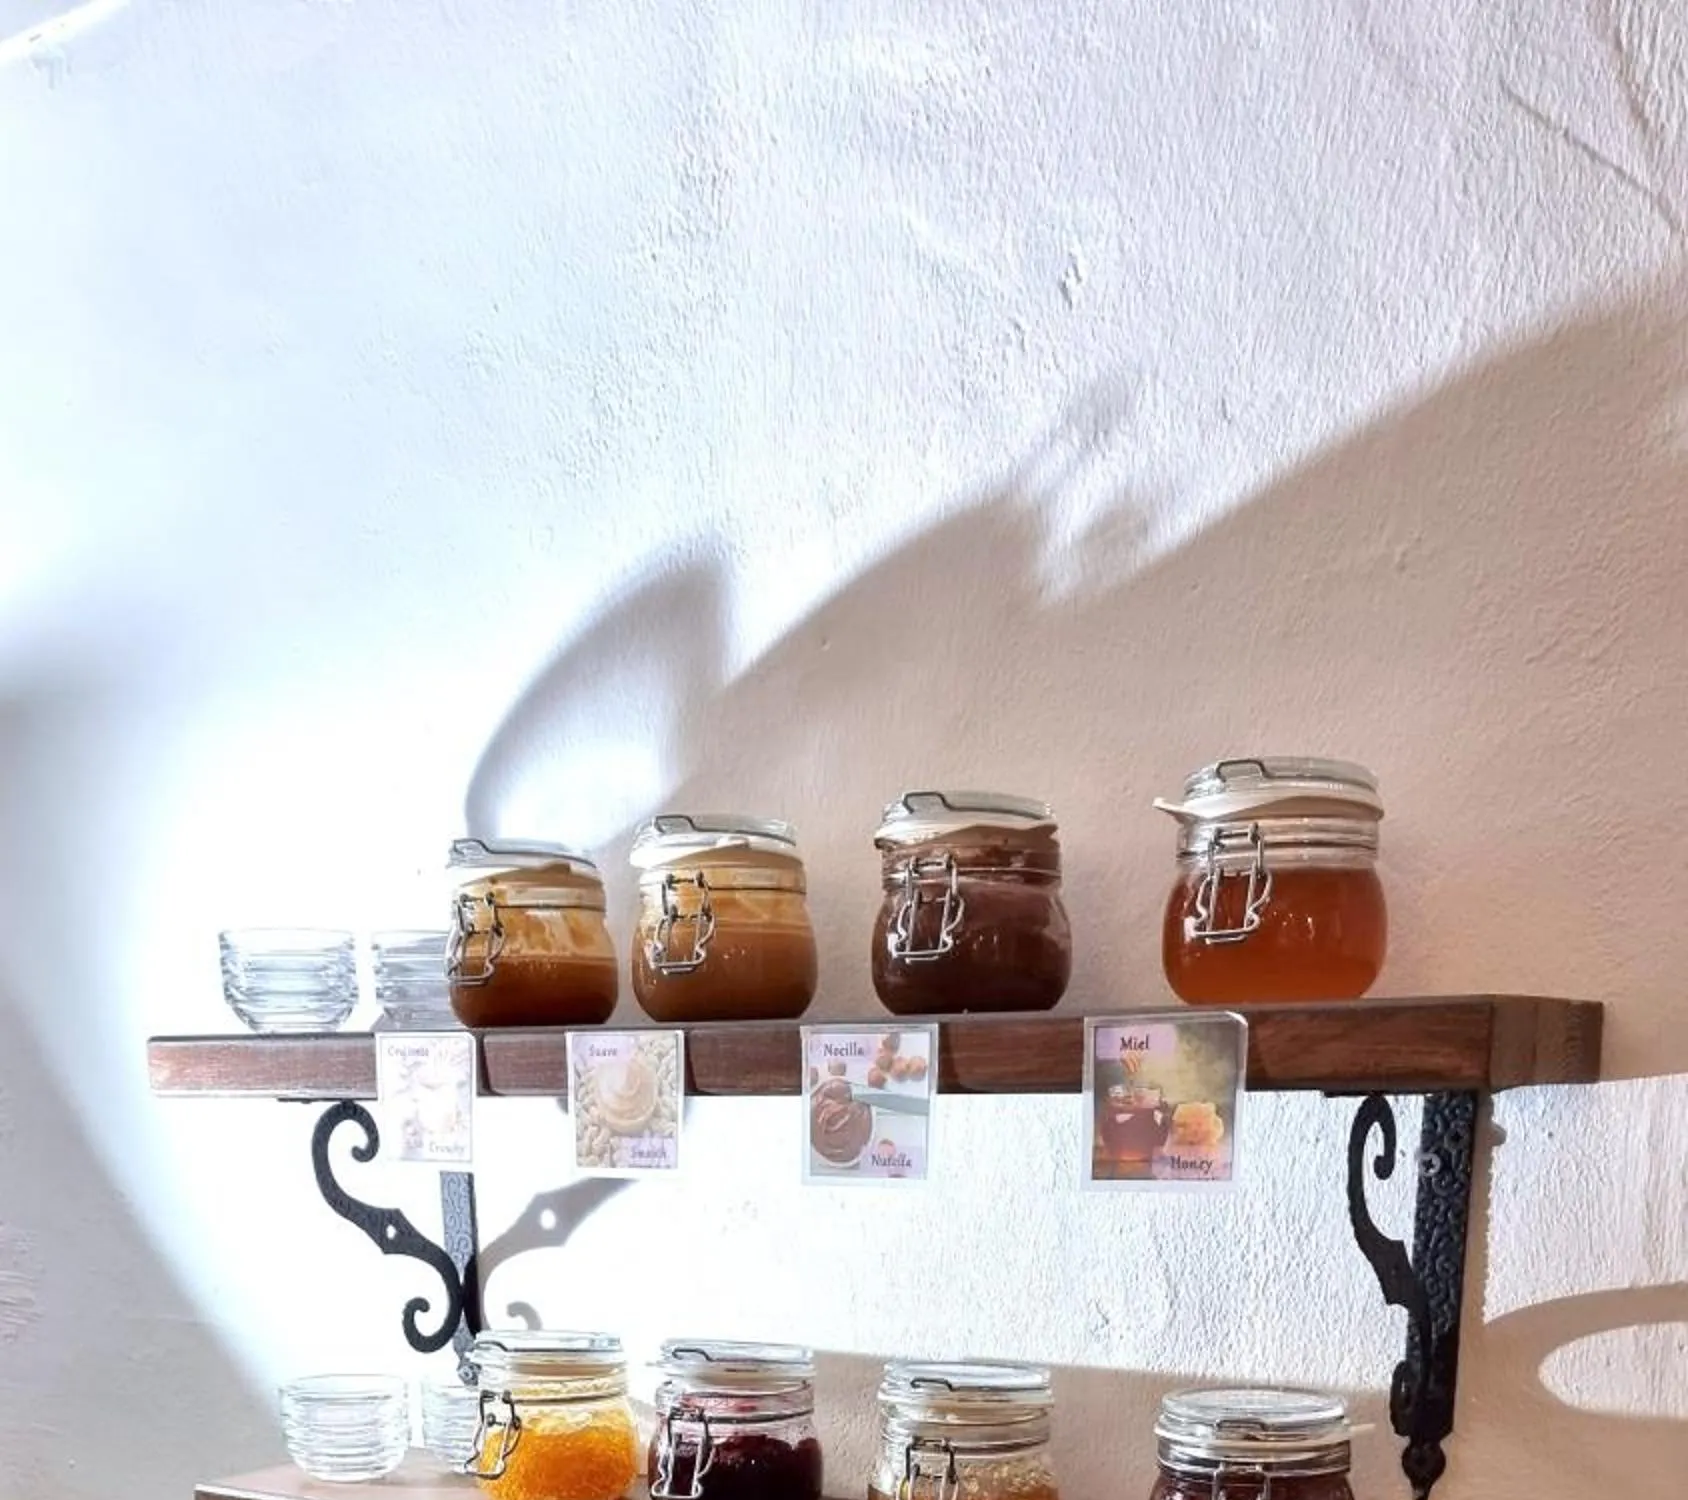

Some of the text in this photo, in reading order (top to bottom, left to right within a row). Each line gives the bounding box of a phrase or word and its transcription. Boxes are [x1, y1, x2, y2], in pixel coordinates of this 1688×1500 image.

[823, 1041, 865, 1057] Nocilla
[1119, 1033, 1150, 1051] Miel
[871, 1153, 913, 1169] Nutella
[1170, 1155, 1213, 1174] Honey
